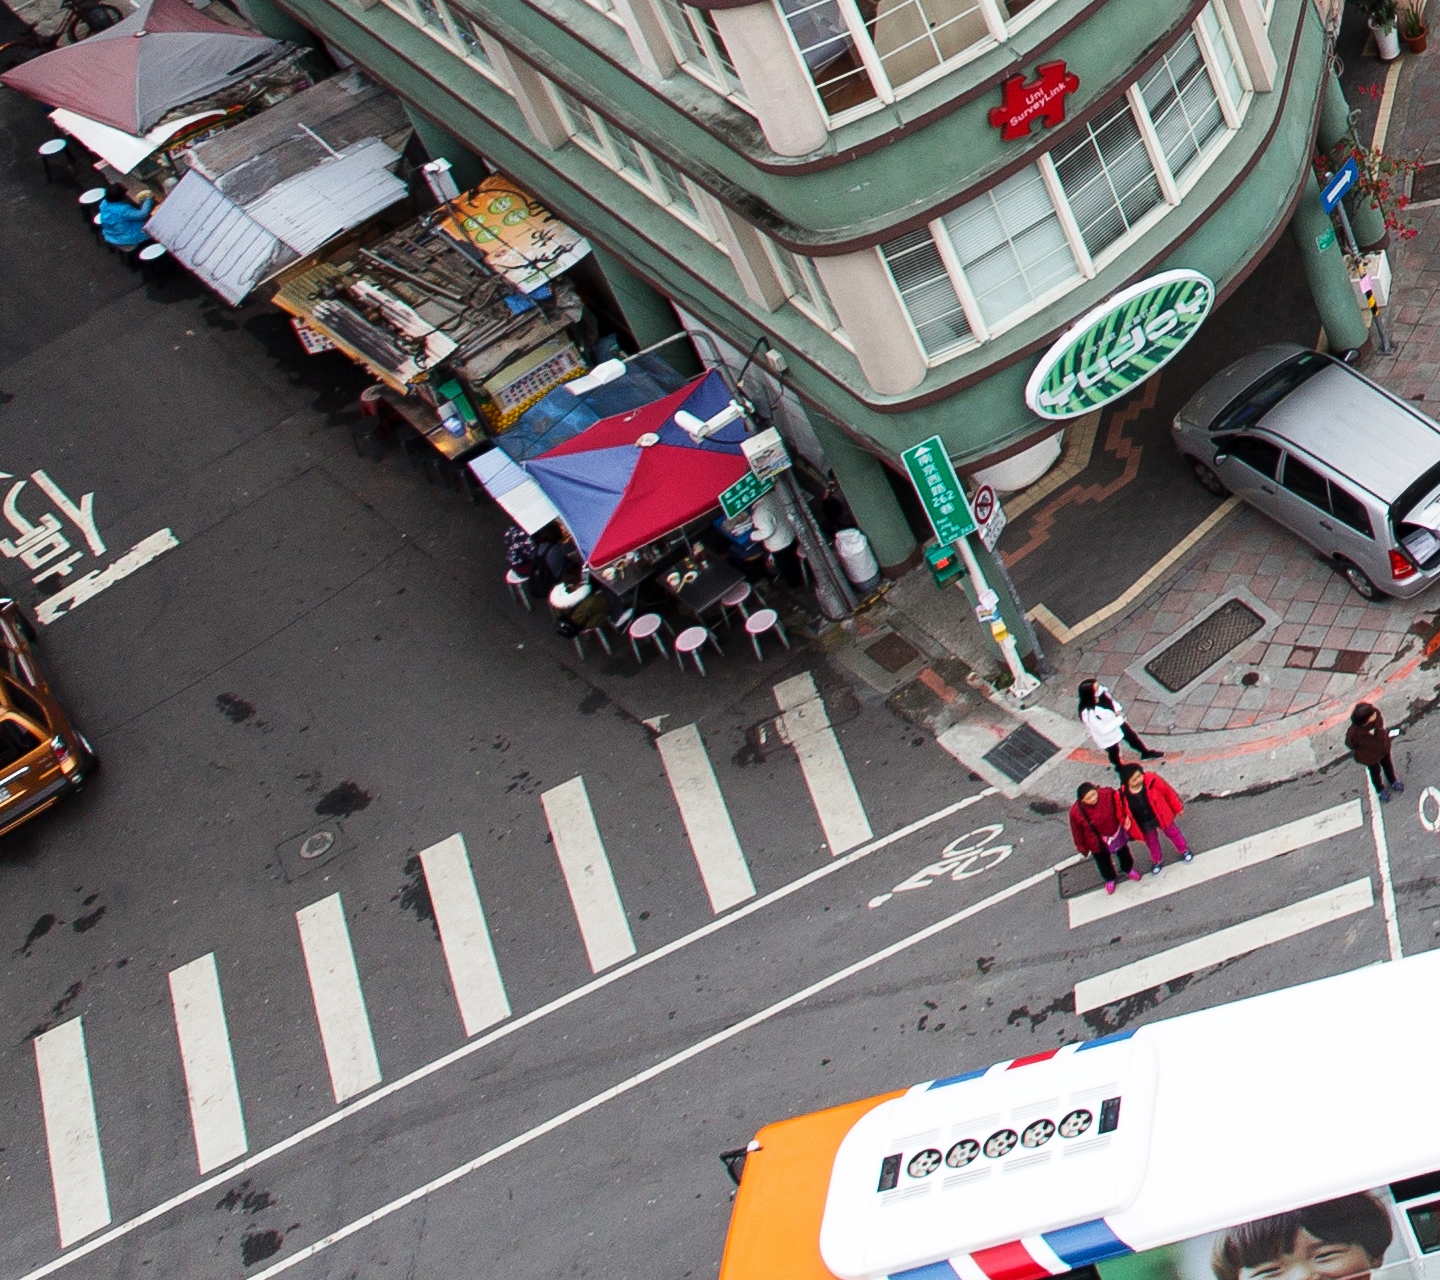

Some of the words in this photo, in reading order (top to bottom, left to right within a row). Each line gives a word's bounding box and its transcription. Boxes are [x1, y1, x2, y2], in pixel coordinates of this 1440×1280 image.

[1009, 81, 1067, 127] SurveyLink
[1025, 87, 1045, 105] Uni
[734, 489, 758, 510] 262
